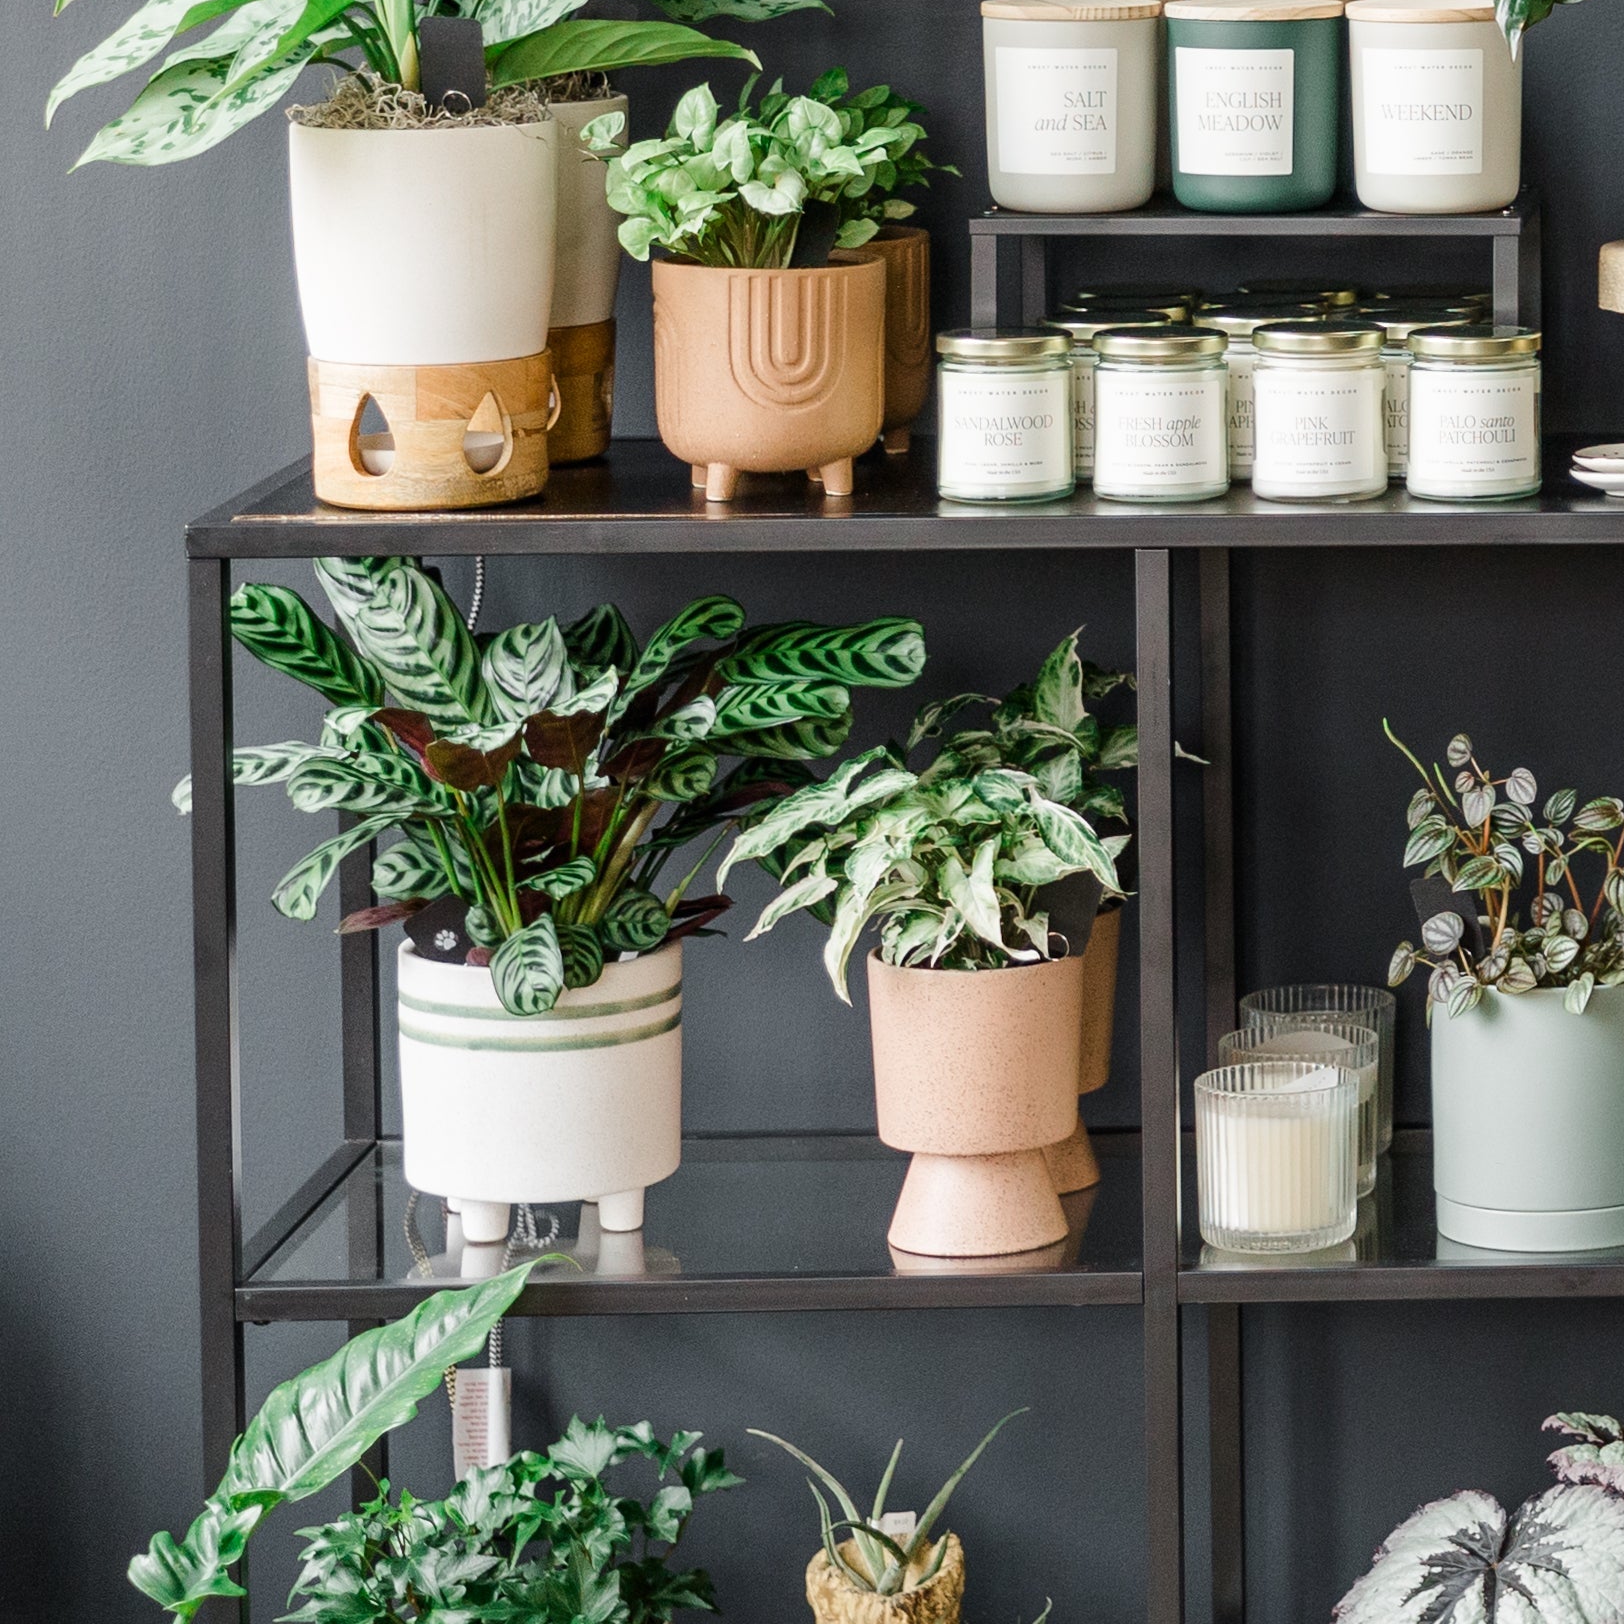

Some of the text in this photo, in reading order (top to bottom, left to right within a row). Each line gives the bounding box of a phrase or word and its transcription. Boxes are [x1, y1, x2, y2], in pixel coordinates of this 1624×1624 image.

[1064, 91, 1107, 108] SALT
[1206, 92, 1282, 108] ENGLISH
[1381, 104, 1472, 120] WEEKEND
[1034, 113, 1107, 131] and SEA
[1198, 115, 1283, 131] MEADOW
[954, 414, 1053, 431] SANDALWOOD
[1119, 414, 1201, 435] FRESH apple
[1295, 416, 1328, 430] PINK
[1440, 415, 1515, 429] PALO santo
[984, 432, 1023, 447] ROSE
[1126, 432, 1194, 447] BLOSSOM
[1270, 430, 1356, 446] GRAPEFRUIT
[1440, 429, 1515, 444] PATCHOULI
